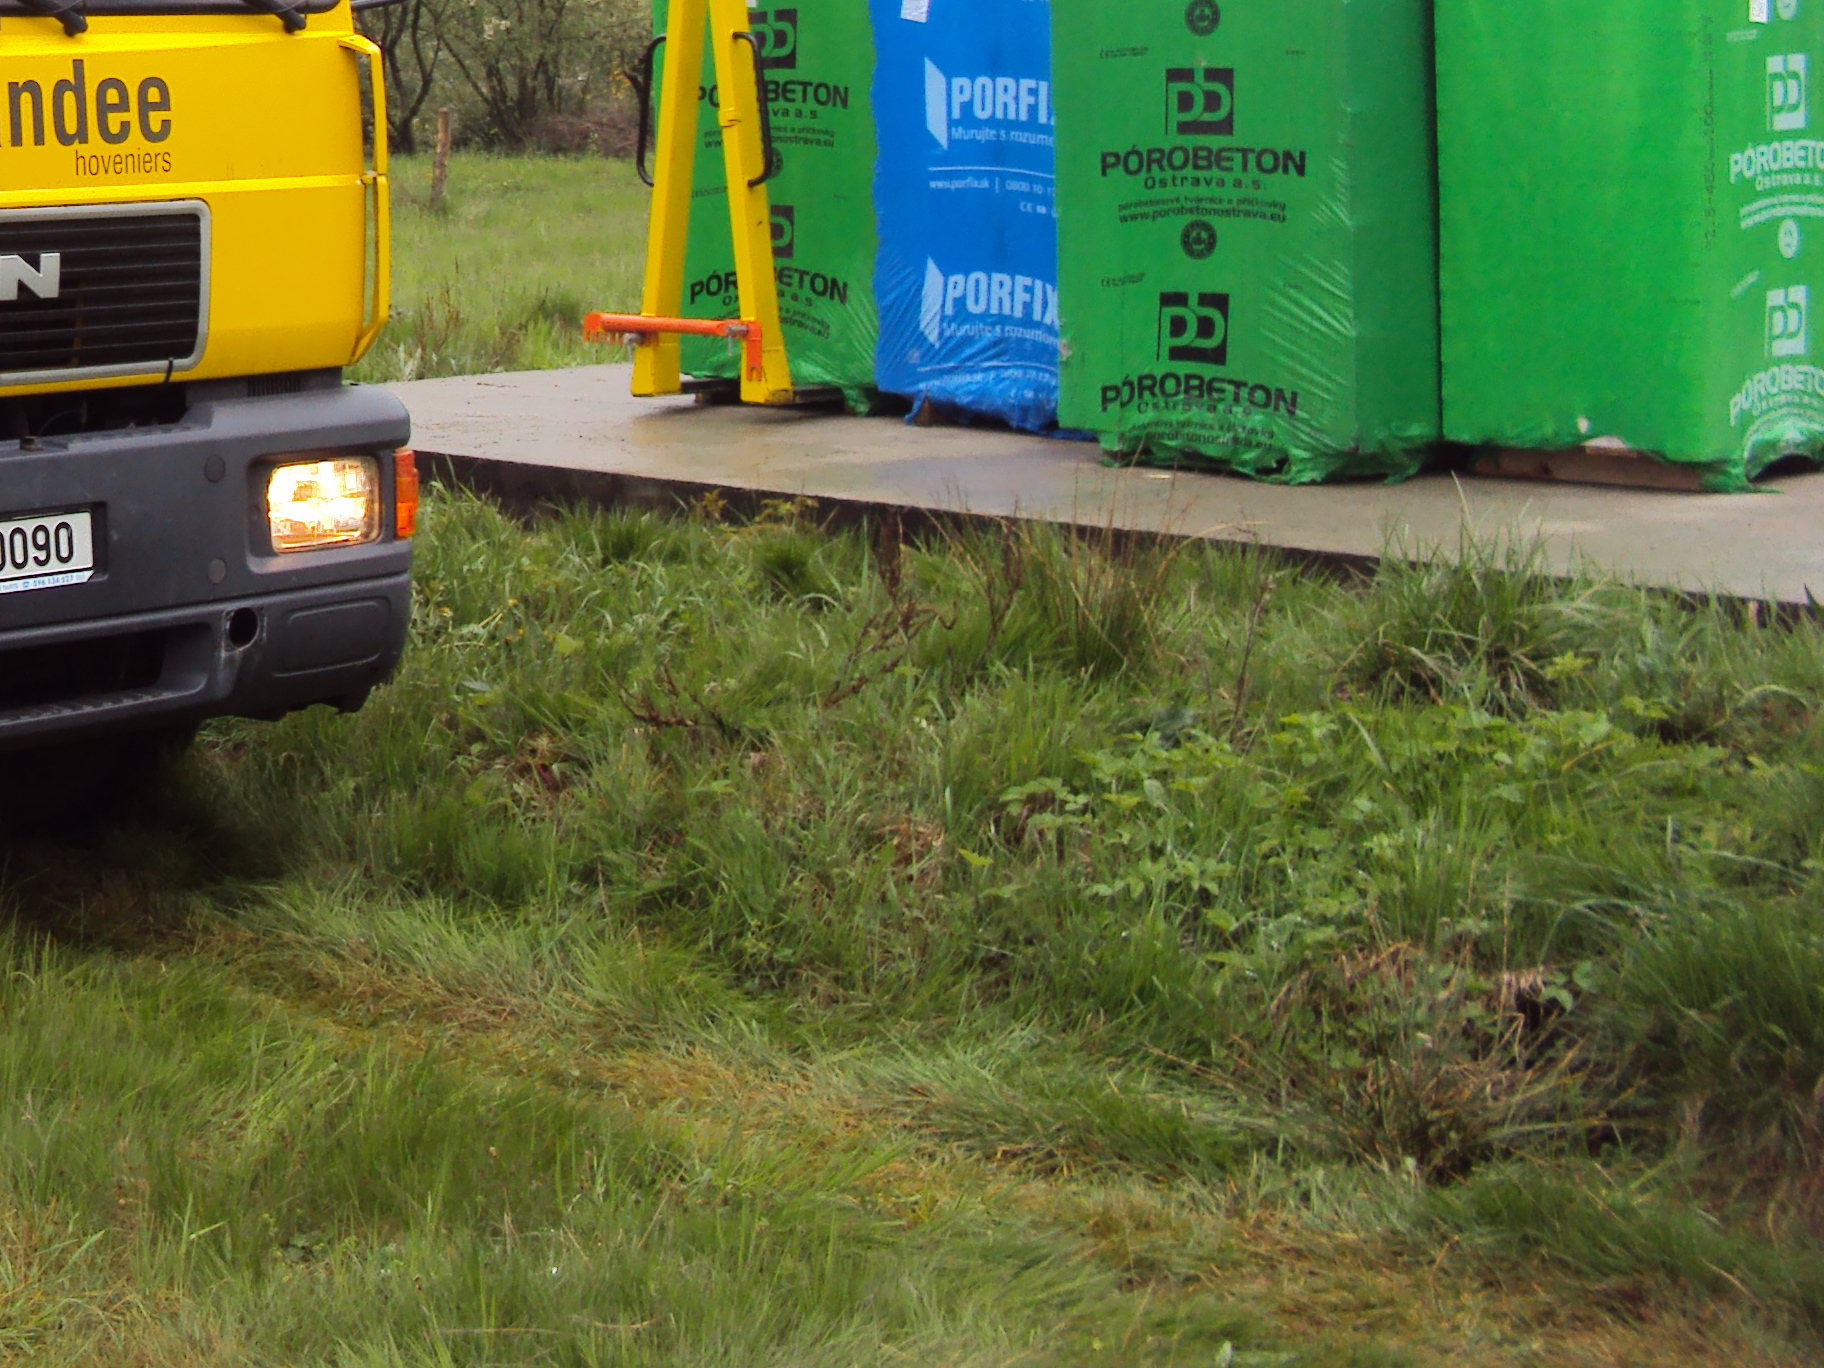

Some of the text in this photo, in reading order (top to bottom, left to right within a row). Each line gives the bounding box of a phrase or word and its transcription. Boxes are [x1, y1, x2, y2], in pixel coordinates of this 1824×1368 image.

[951, 76, 1055, 125] PORFI
[75, 149, 172, 177] hoveniers
[1100, 144, 1306, 177] PÓROBETON
[1144, 174, 1225, 190] Ostrava
[1730, 139, 1824, 184] PÓROBETO
[944, 271, 1060, 331] PORFIX
[1101, 372, 1298, 415] PÓROBETON
